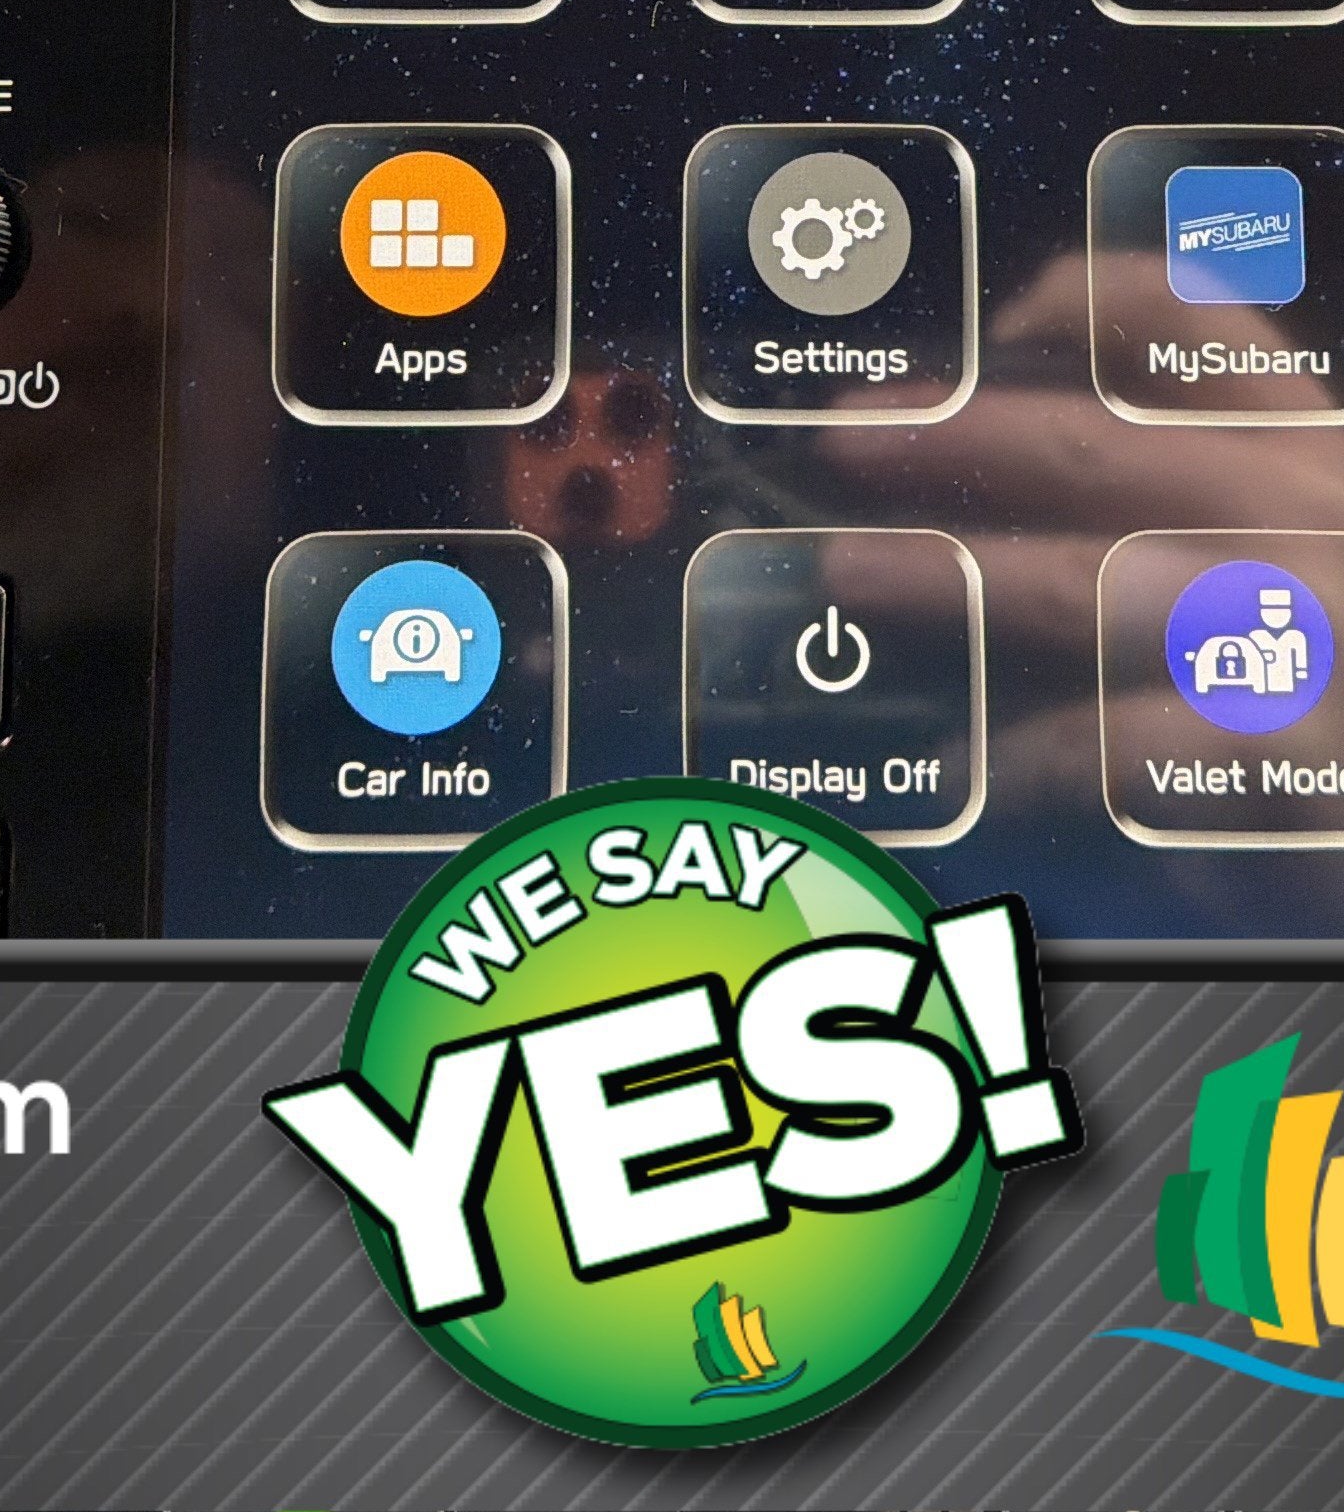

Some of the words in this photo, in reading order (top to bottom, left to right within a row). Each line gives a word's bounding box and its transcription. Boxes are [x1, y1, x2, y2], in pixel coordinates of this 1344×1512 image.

[1179, 213, 1291, 252] MYSUBARU
[374, 342, 468, 382] Apps
[754, 340, 909, 382] Settings
[1149, 342, 1330, 383] MySubaru
[337, 761, 407, 798] Car
[422, 761, 490, 797] Info
[728, 756, 866, 804] Display
[883, 757, 941, 794] Off
[1145, 759, 1246, 794] Valet
